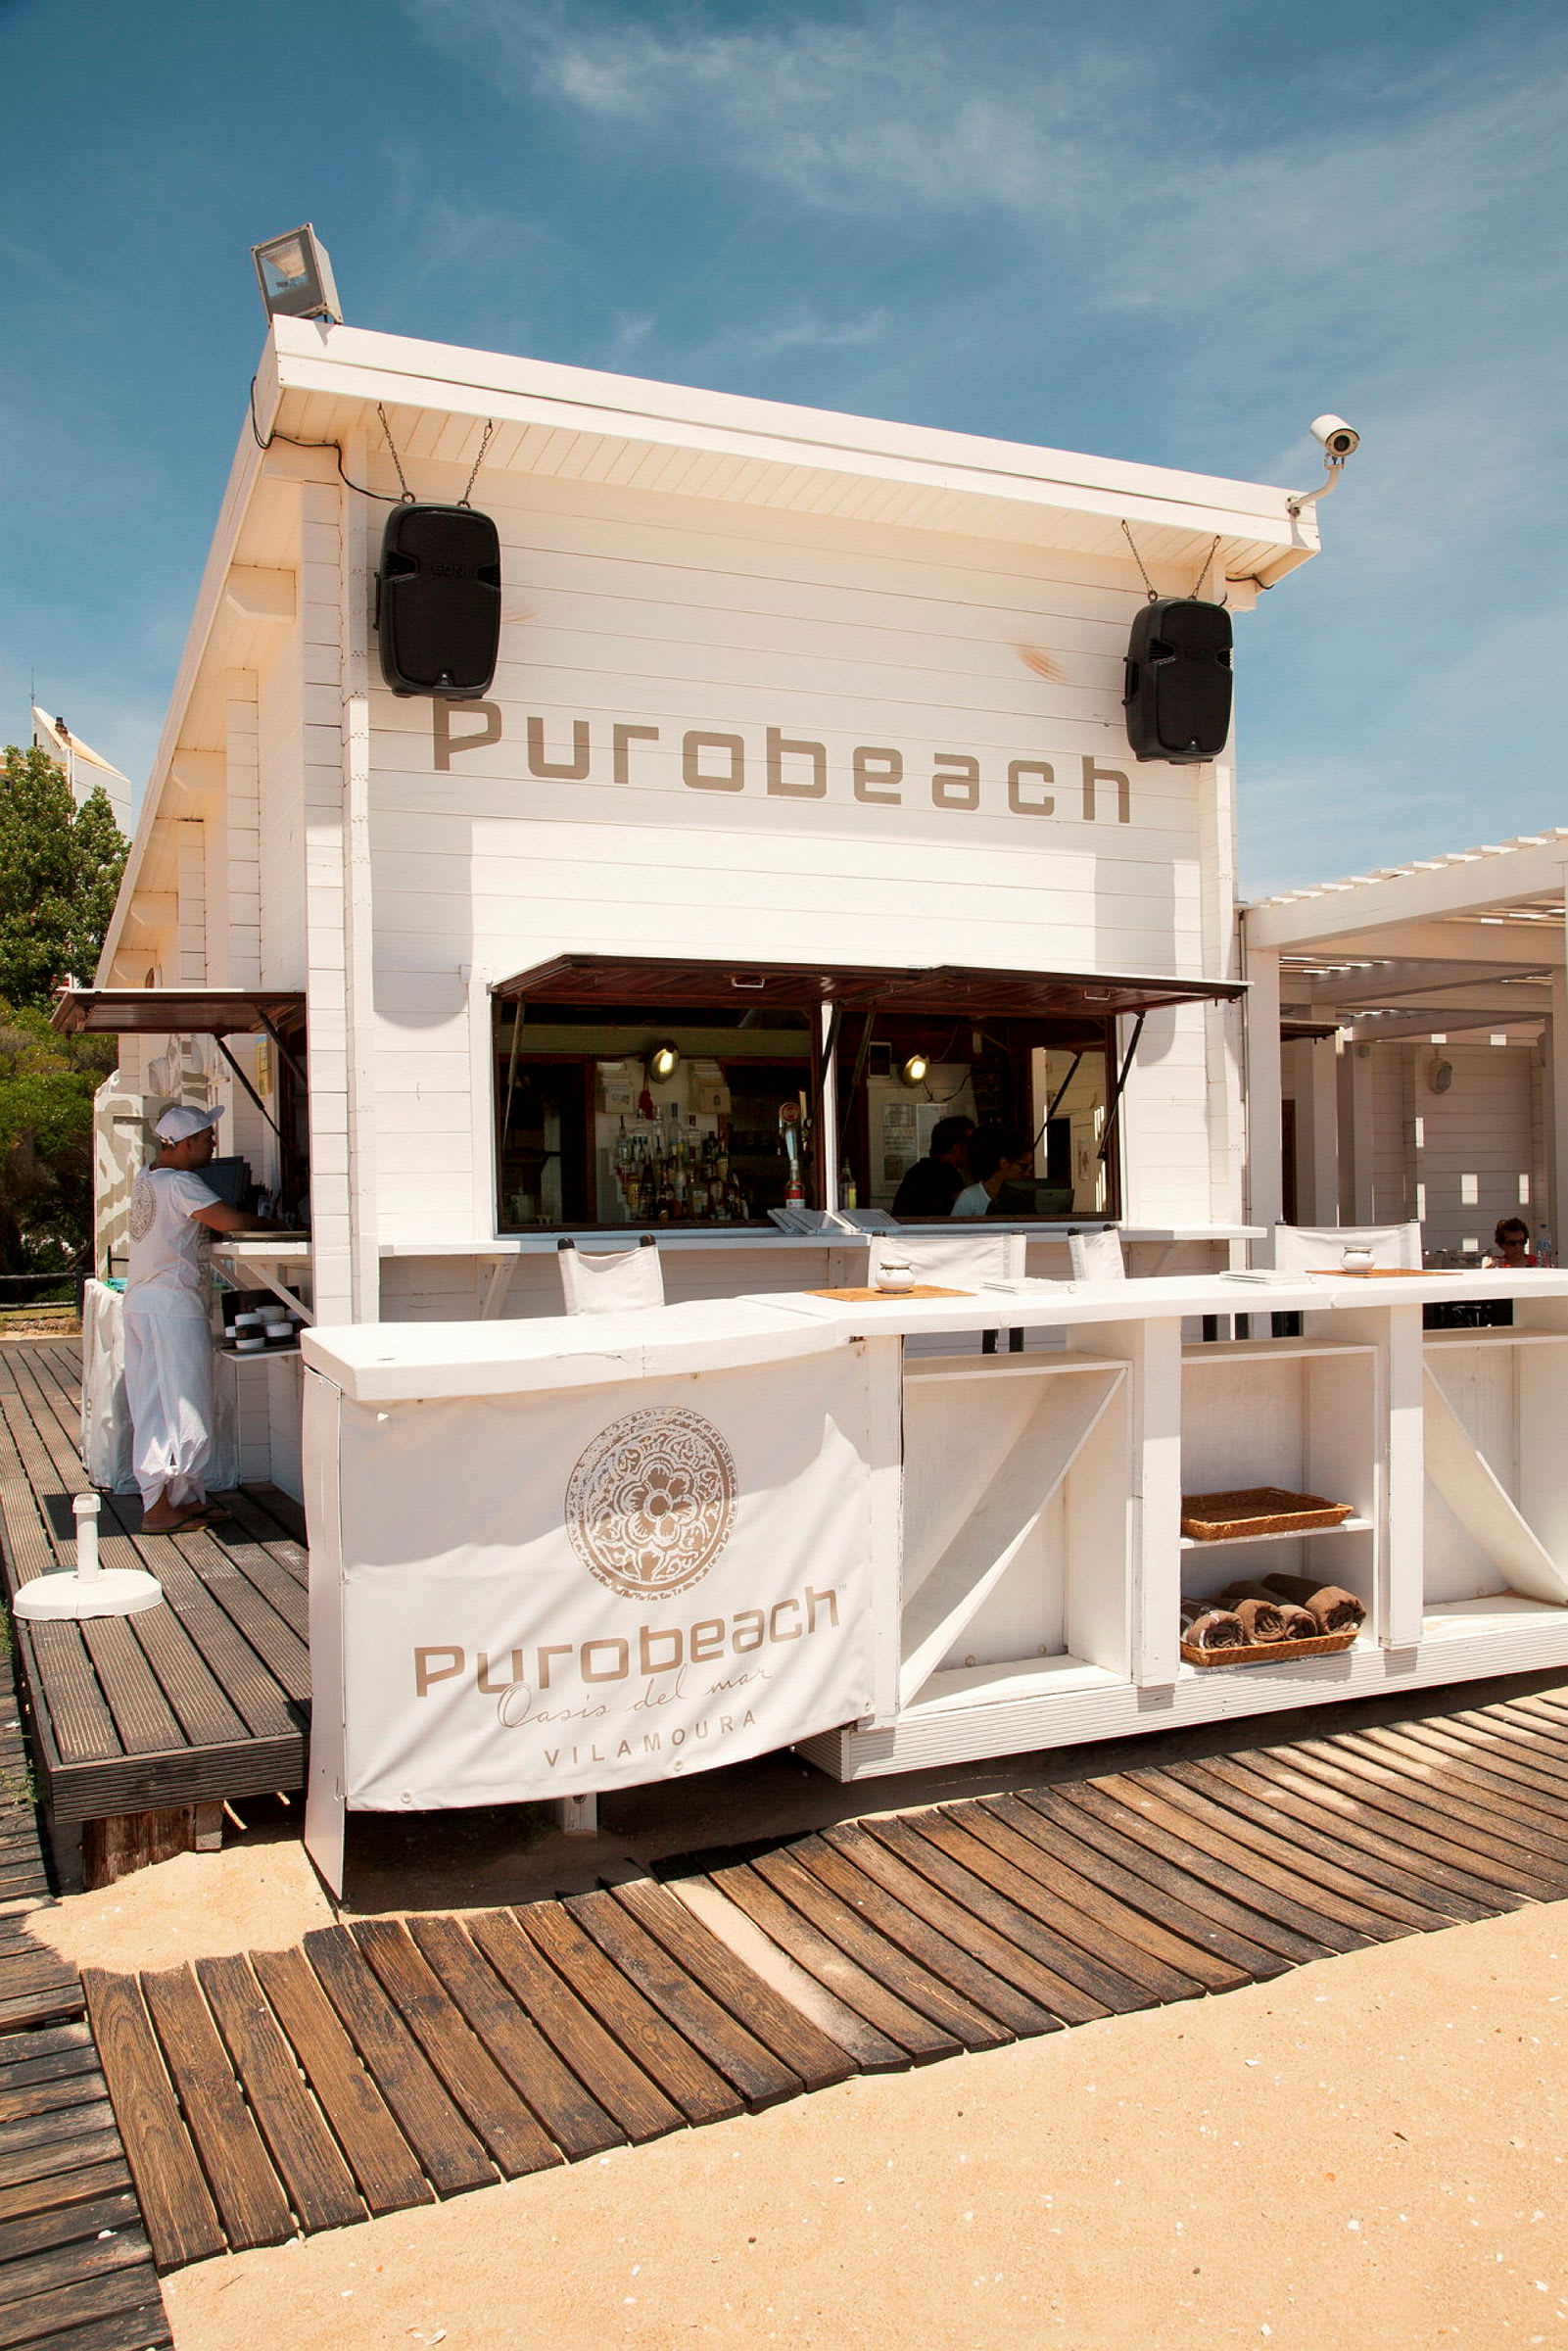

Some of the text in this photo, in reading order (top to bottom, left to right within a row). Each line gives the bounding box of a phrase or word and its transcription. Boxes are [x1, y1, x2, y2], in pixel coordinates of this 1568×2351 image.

[433, 696, 1131, 825] Purobeach
[497, 1662, 773, 1729] Oasis del mar
[545, 1709, 757, 1767] VILAMOURA
